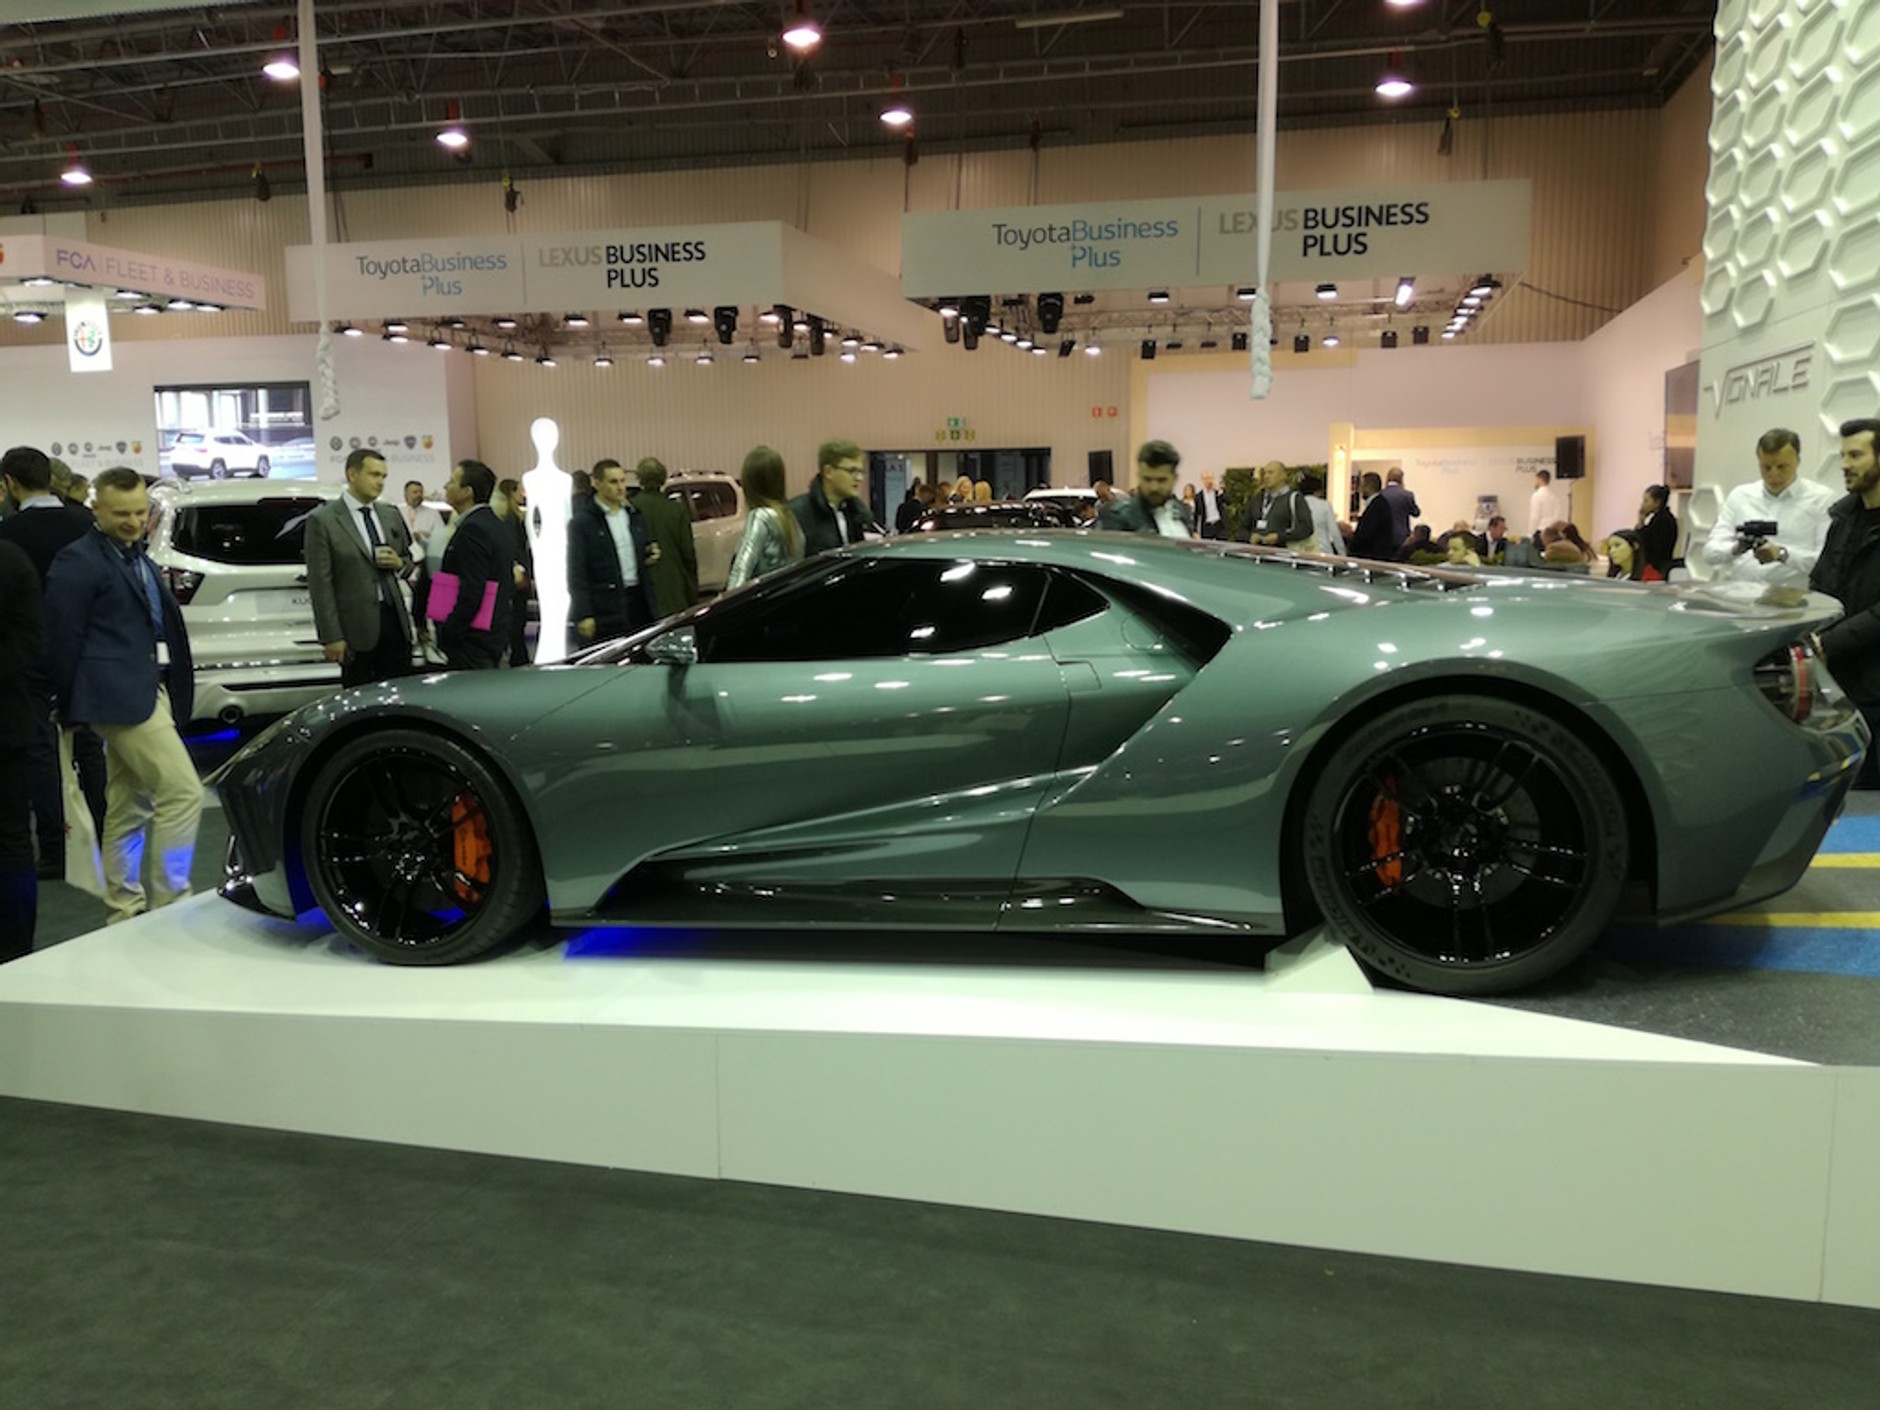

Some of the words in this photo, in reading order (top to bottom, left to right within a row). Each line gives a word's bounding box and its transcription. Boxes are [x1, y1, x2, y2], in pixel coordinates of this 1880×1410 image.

[1303, 202, 1430, 230] BUSINESS
[539, 246, 602, 268] LEXUS
[605, 241, 706, 265] BUSINESS
[1071, 244, 1121, 268] Plus
[1302, 232, 1368, 257] PLUS
[56, 249, 97, 273] FCA
[106, 257, 158, 283] FLEET
[164, 267, 175, 287] &
[180, 270, 254, 300] BUSINESS
[421, 275, 463, 296] Plus
[607, 267, 659, 289] PLUS
